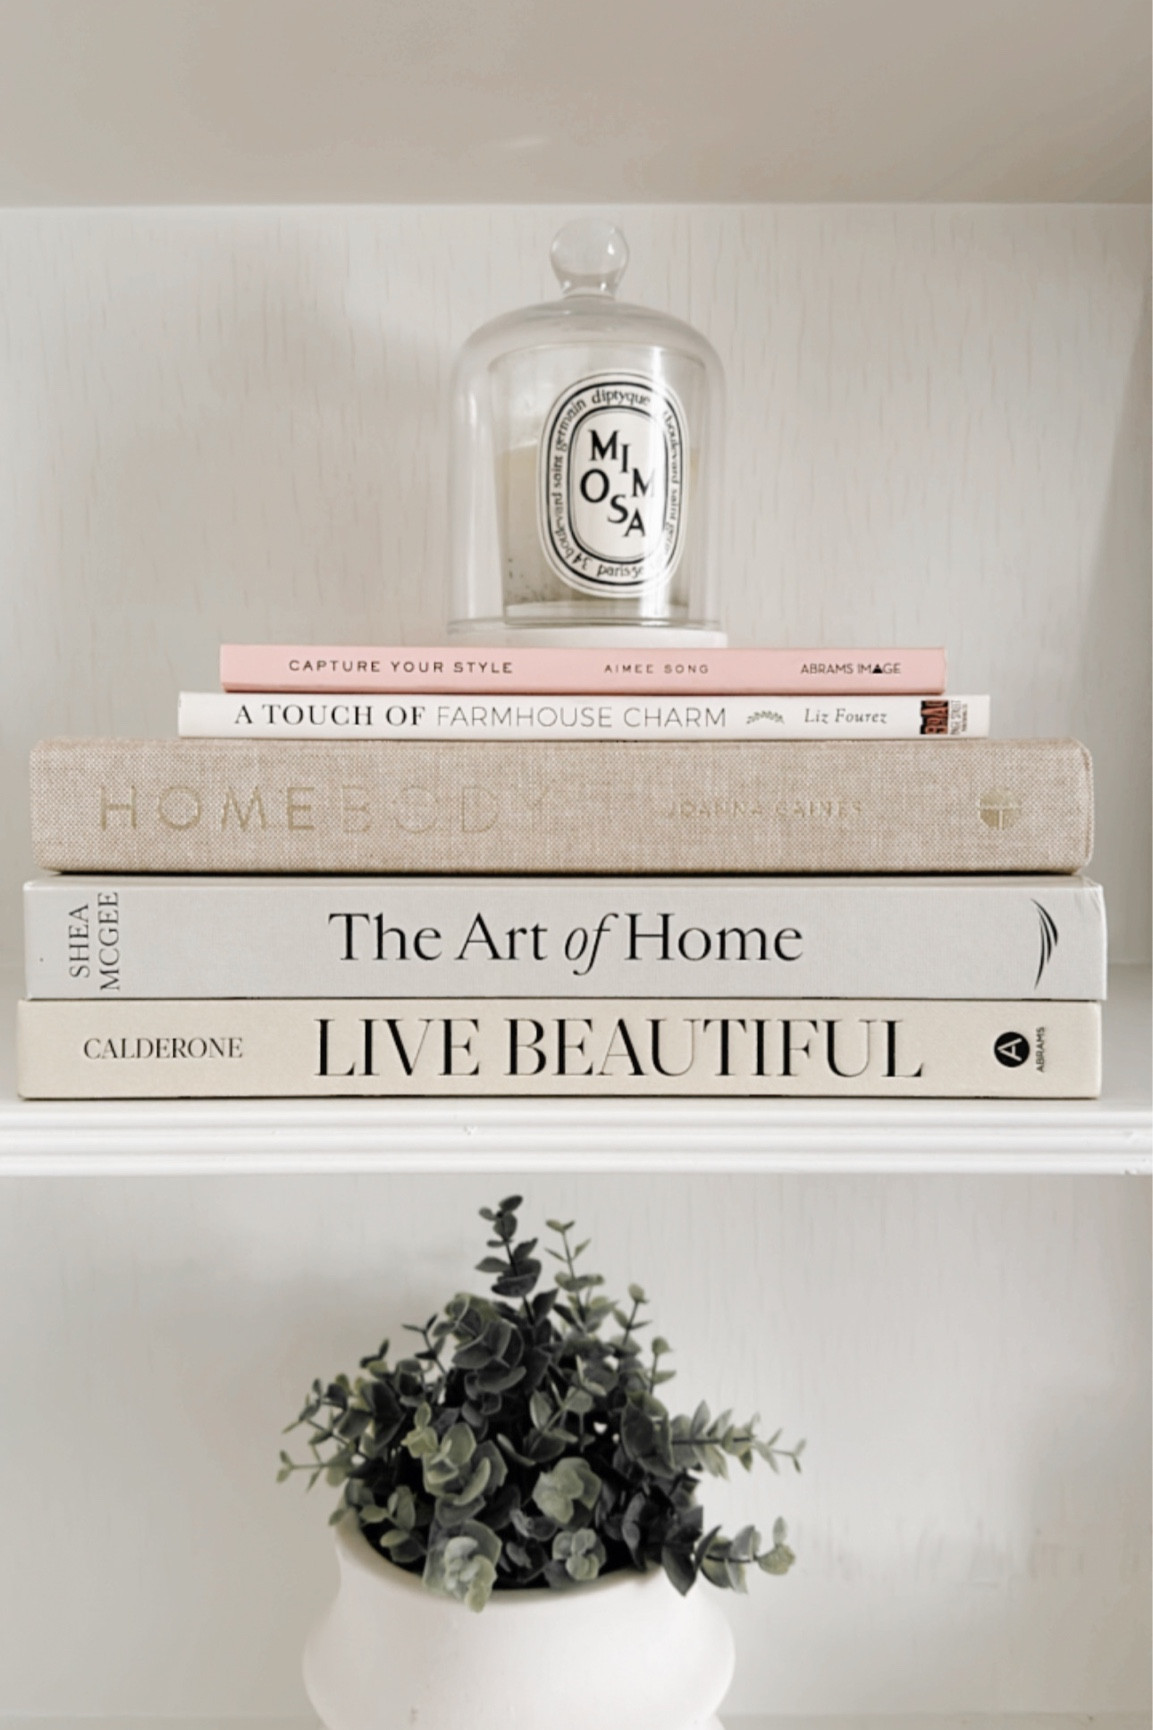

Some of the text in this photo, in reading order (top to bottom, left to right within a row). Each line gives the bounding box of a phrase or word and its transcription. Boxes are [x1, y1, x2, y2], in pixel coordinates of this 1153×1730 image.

[592, 388, 651, 406] diptyque
[555, 398, 588, 453] germain
[551, 455, 563, 489] saint
[552, 492, 575, 559] boulevard
[288, 659, 514, 674] CAPTURE YOUR STYLE
[604, 663, 710, 675] AIMEE SONG
[800, 662, 854, 675] ABRAMS
[234, 704, 727, 729] A TOUCH OF FARMHOUSE CHARM
[804, 707, 888, 725] Liz Fourez
[99, 784, 549, 834] HOMEBODY
[668, 799, 862, 818] JOANNA GAINES
[68, 903, 90, 979] SHEA
[97, 891, 121, 991] MCGEE
[328, 911, 804, 976] The Art of Home
[83, 1037, 244, 1060] CALDERONE
[314, 1017, 924, 1079] LIVE BEAUTIFUL
[1035, 1026, 1046, 1073] ABRAMS
